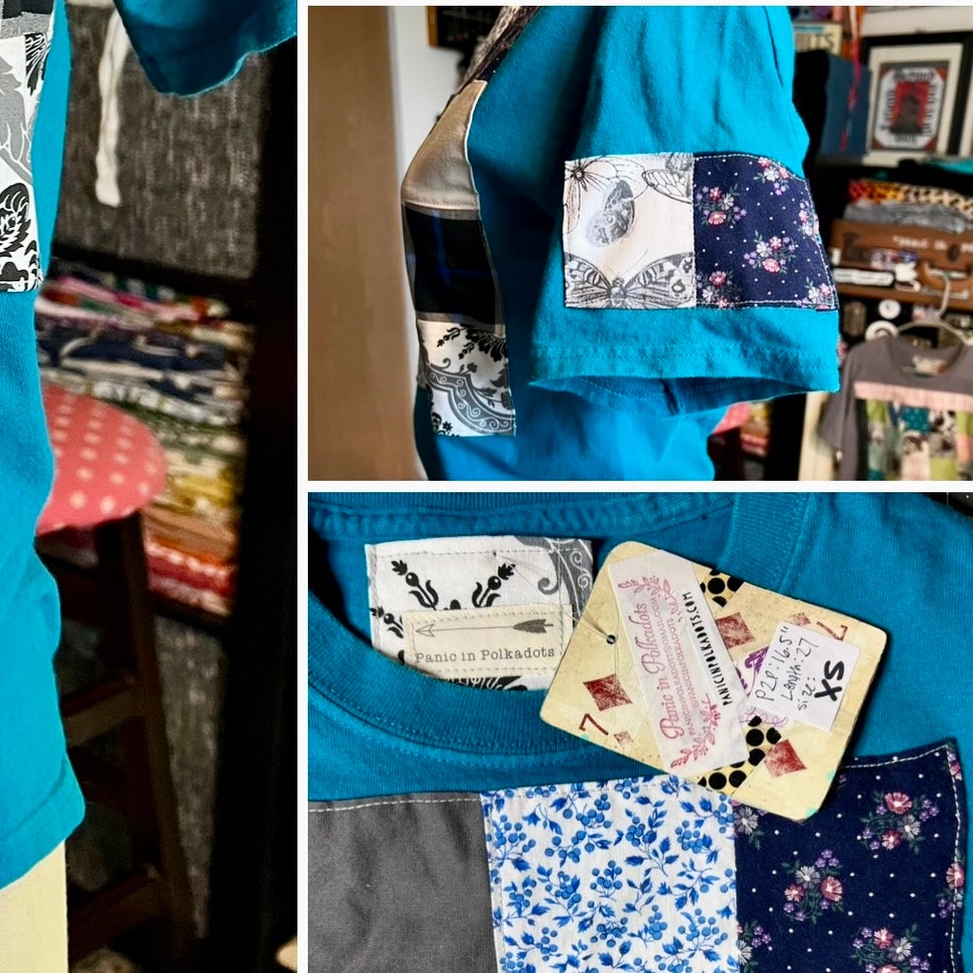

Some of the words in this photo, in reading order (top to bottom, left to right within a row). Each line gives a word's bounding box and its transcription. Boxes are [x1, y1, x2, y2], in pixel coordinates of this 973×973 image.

[628, 603, 666, 675] Polkadots
[816, 621, 848, 641] 7
[415, 652, 457, 663] Panic
[461, 651, 476, 661] in
[481, 647, 555, 660] Polkadots
[682, 592, 733, 706] PANICINPOLKADOTS.COM
[657, 676, 670, 692] in
[814, 660, 845, 702] XS
[579, 713, 609, 736] 7
[660, 694, 684, 739] Panic
